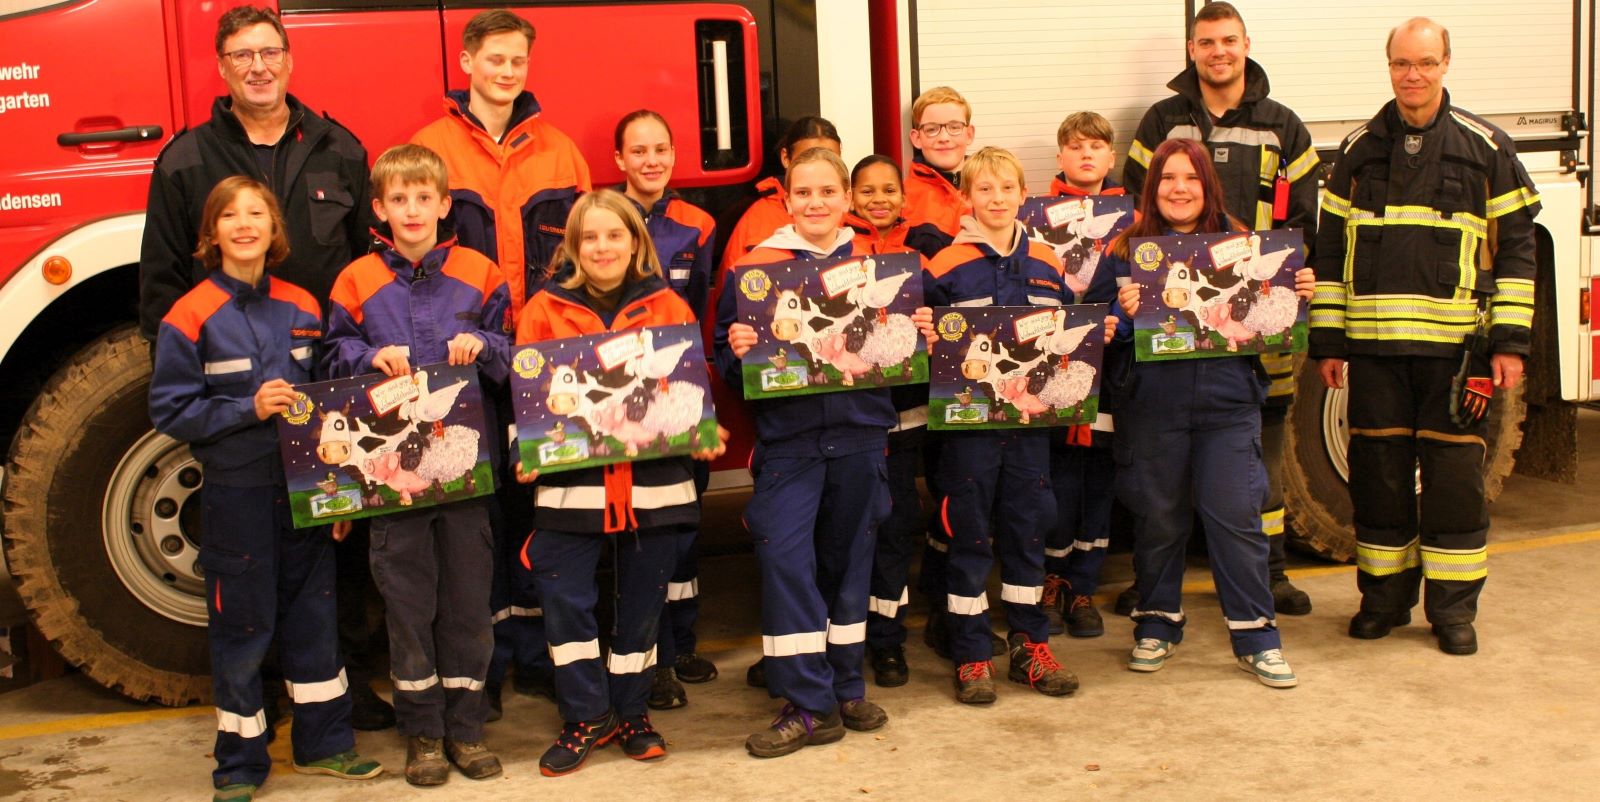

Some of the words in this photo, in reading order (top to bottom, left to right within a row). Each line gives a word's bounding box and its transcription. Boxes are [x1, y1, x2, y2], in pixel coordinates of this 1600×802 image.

[0, 62, 40, 80] wehr
[1528, 117, 1558, 125] MAGIRUS
[0, 193, 62, 210] densen
[1145, 251, 1154, 262] L
[950, 321, 957, 332] L
